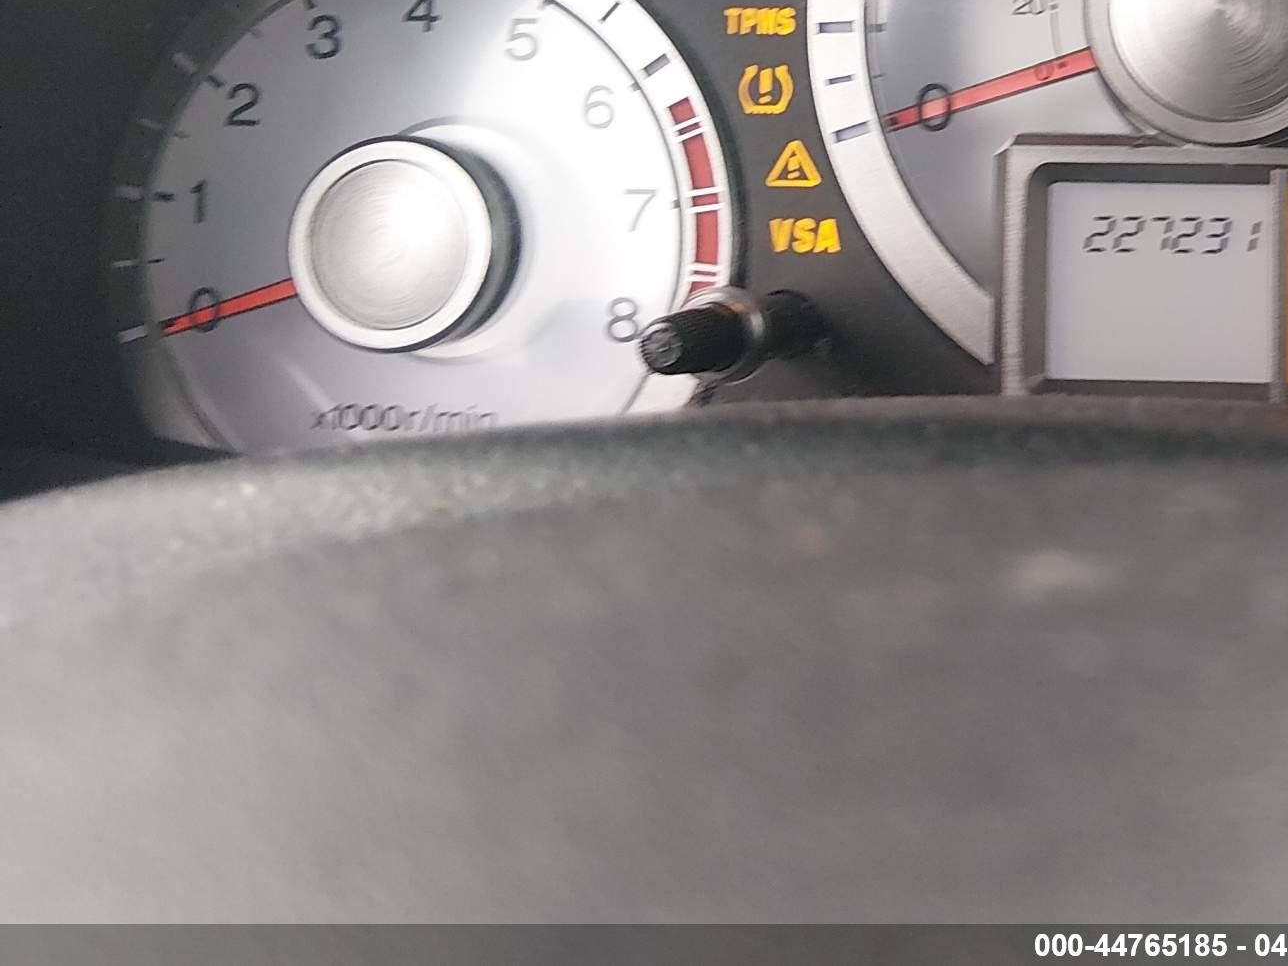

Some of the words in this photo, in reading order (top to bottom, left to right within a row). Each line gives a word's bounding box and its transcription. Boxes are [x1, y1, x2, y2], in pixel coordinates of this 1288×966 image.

[306, 14, 341, 59] 3
[505, 18, 539, 60] 5
[724, 7, 797, 35] TPMS
[225, 82, 261, 127] 2
[584, 85, 615, 129] 6
[917, 84, 951, 131] 0
[191, 180, 207, 223] 1
[624, 189, 657, 232] 7
[769, 218, 841, 253] VSA
[1083, 216, 1263, 253] 227231
[189, 288, 220, 332] 0
[607, 298, 640, 343] 8
